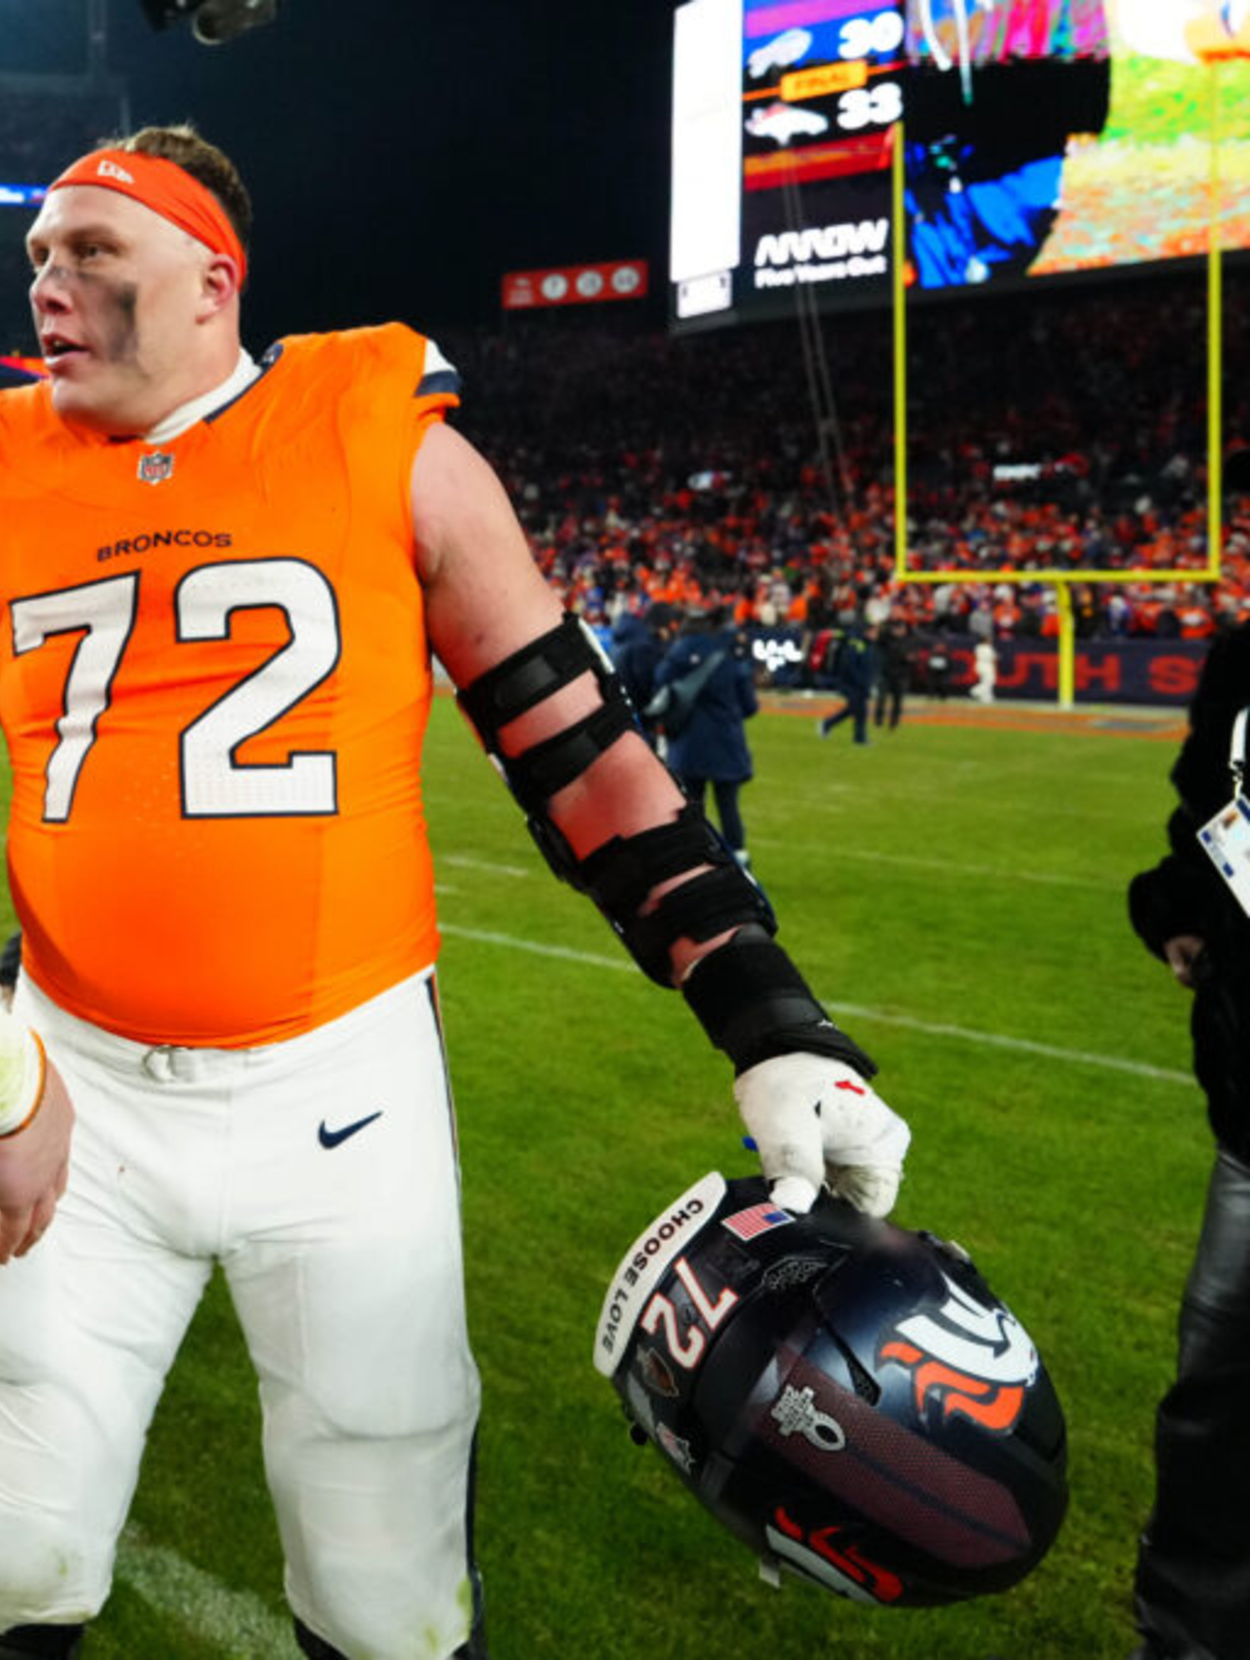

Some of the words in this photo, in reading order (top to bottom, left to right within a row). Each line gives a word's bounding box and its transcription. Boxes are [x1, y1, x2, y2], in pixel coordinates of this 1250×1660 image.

[754, 218, 889, 267] ARROW
[97, 529, 232, 562] BRONCOS
[8, 556, 342, 824] 72
[1148, 655, 1203, 694] S
[623, 1199, 704, 1288] CHOOSE
[601, 1287, 630, 1356] LOVE
[640, 1256, 740, 1370] 72
